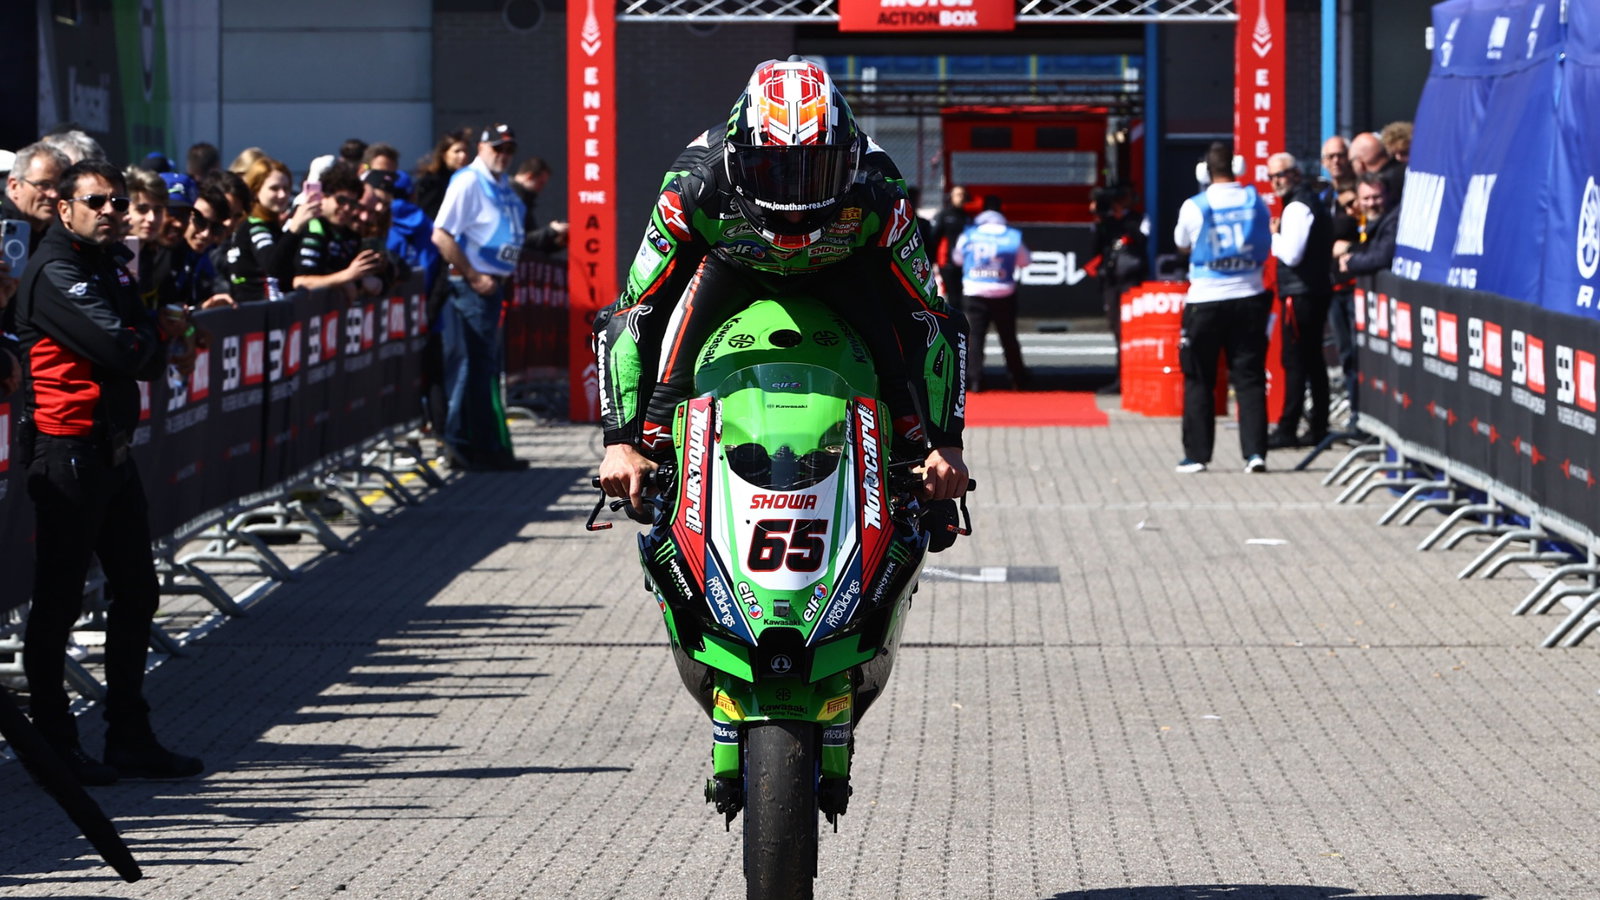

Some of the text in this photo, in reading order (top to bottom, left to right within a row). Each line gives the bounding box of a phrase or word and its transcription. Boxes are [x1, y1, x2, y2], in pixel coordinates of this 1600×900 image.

[583, 66, 601, 182] ENTER
[1254, 68, 1272, 182] ENTER
[578, 191, 606, 204] THE
[754, 198, 836, 211] www.jonathan-rea.com
[900, 229, 920, 260] elf
[1142, 292, 1188, 314] MOT
[700, 317, 742, 369] Kawasaki
[597, 329, 611, 417] Kawasaki
[954, 332, 967, 419] Kawasaki
[750, 494, 818, 509] SHOWA
[747, 519, 829, 573] 65
[737, 581, 760, 609] elf
[803, 595, 821, 622] elf
[763, 618, 800, 627] Kawasaki
[759, 703, 808, 715] Kawasaki
